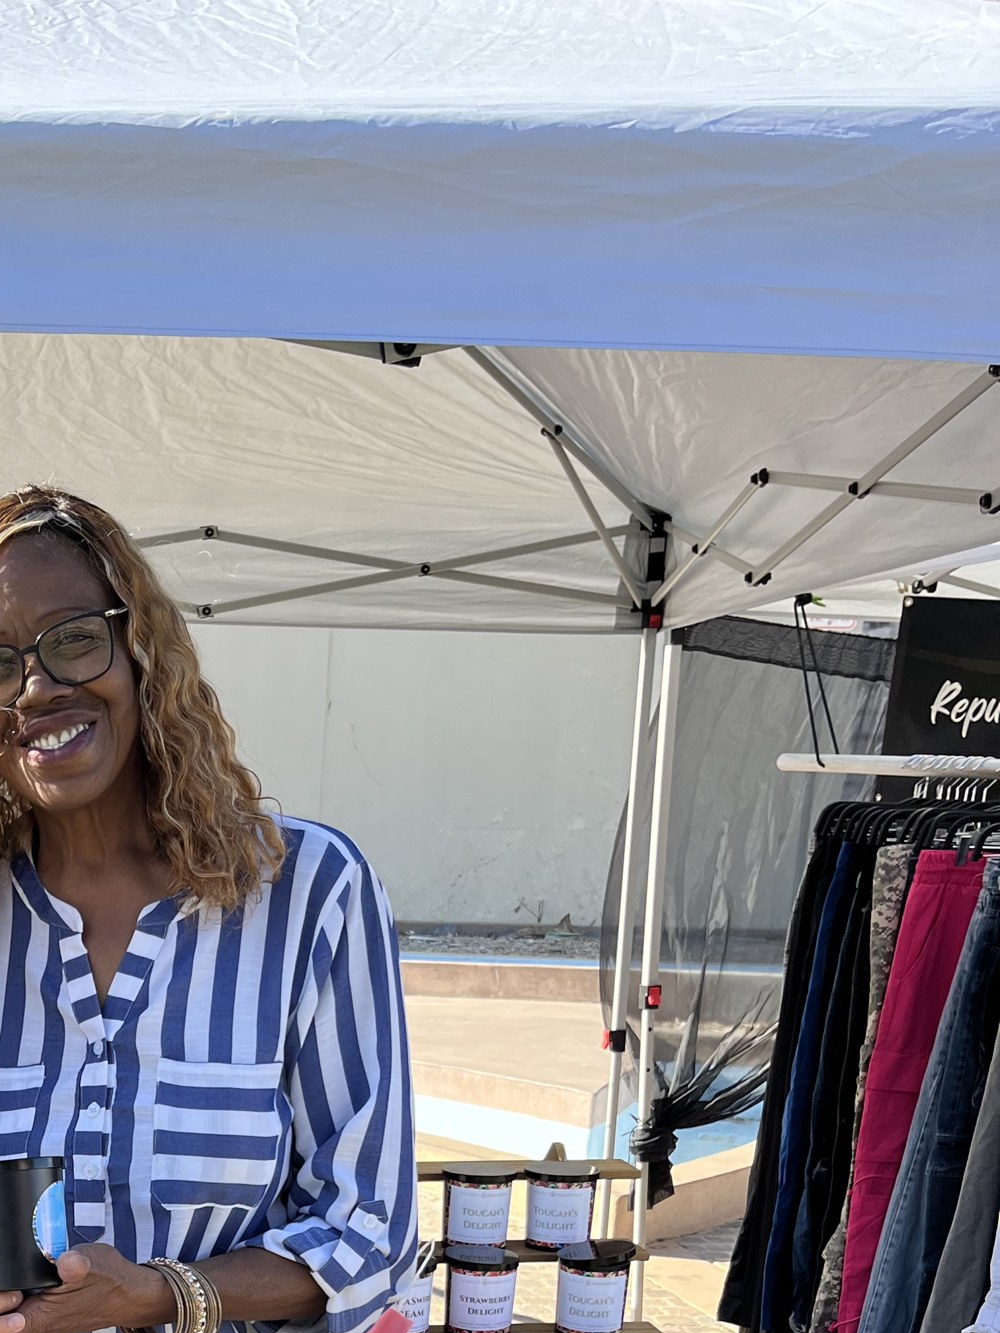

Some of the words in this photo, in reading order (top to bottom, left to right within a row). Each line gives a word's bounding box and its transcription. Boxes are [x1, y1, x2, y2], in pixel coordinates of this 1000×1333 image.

[930, 680, 1000, 738] Repu
[462, 1207, 505, 1217] TOUCAN'S
[534, 1206, 578, 1218] TOUCAN'S
[464, 1220, 502, 1230] DELIGHT
[534, 1220, 574, 1231] DELIGHT
[460, 1294, 510, 1304] STRAWBERRY
[568, 1294, 615, 1305] TOUCAN'S
[468, 1307, 504, 1316] DELIGHT
[569, 1306, 610, 1318] DELIGHT
